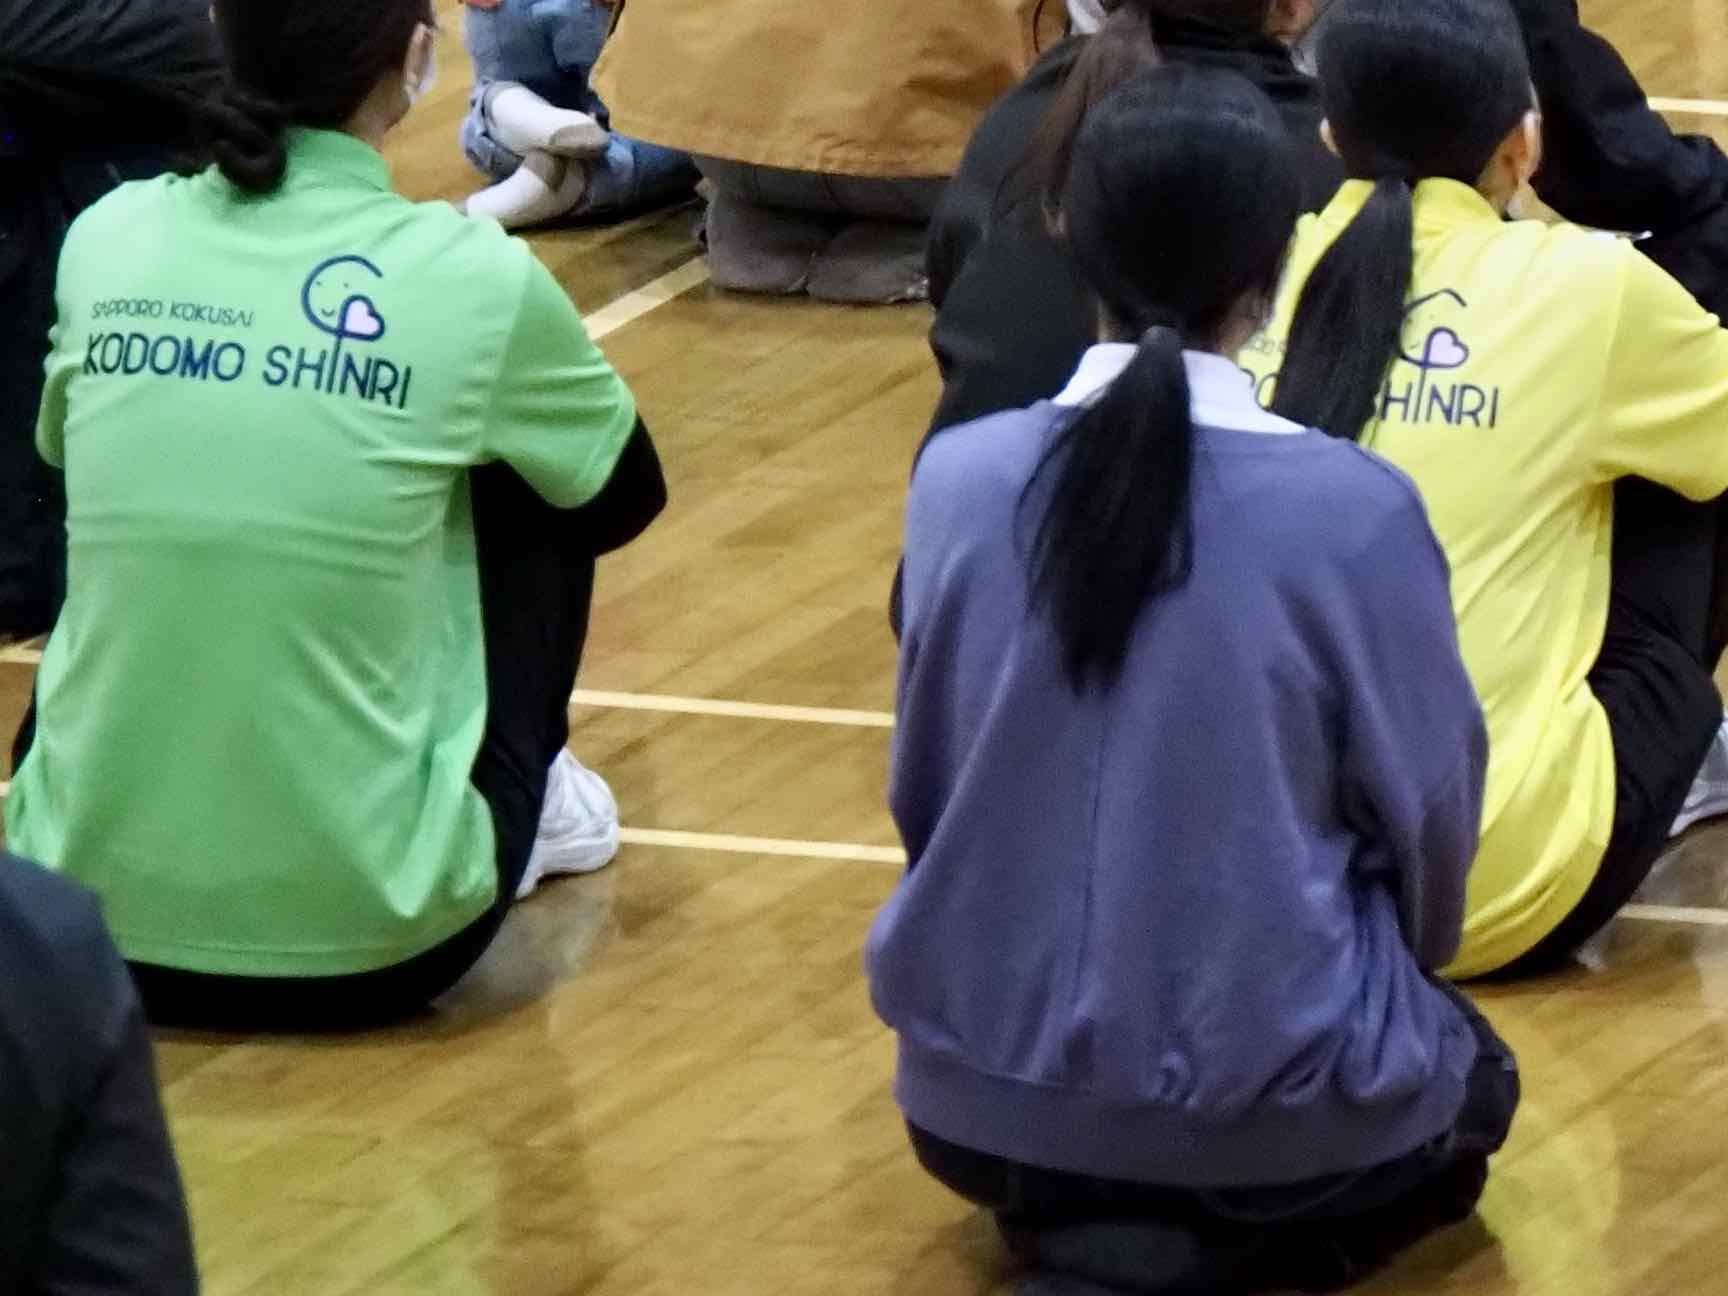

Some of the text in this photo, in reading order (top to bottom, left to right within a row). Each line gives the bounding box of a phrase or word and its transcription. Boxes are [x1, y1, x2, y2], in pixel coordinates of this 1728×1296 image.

[168, 301, 255, 328] KOKUSAI
[83, 332, 412, 410] KODOMO SHINRI
[1379, 376, 1499, 429] HINRI
